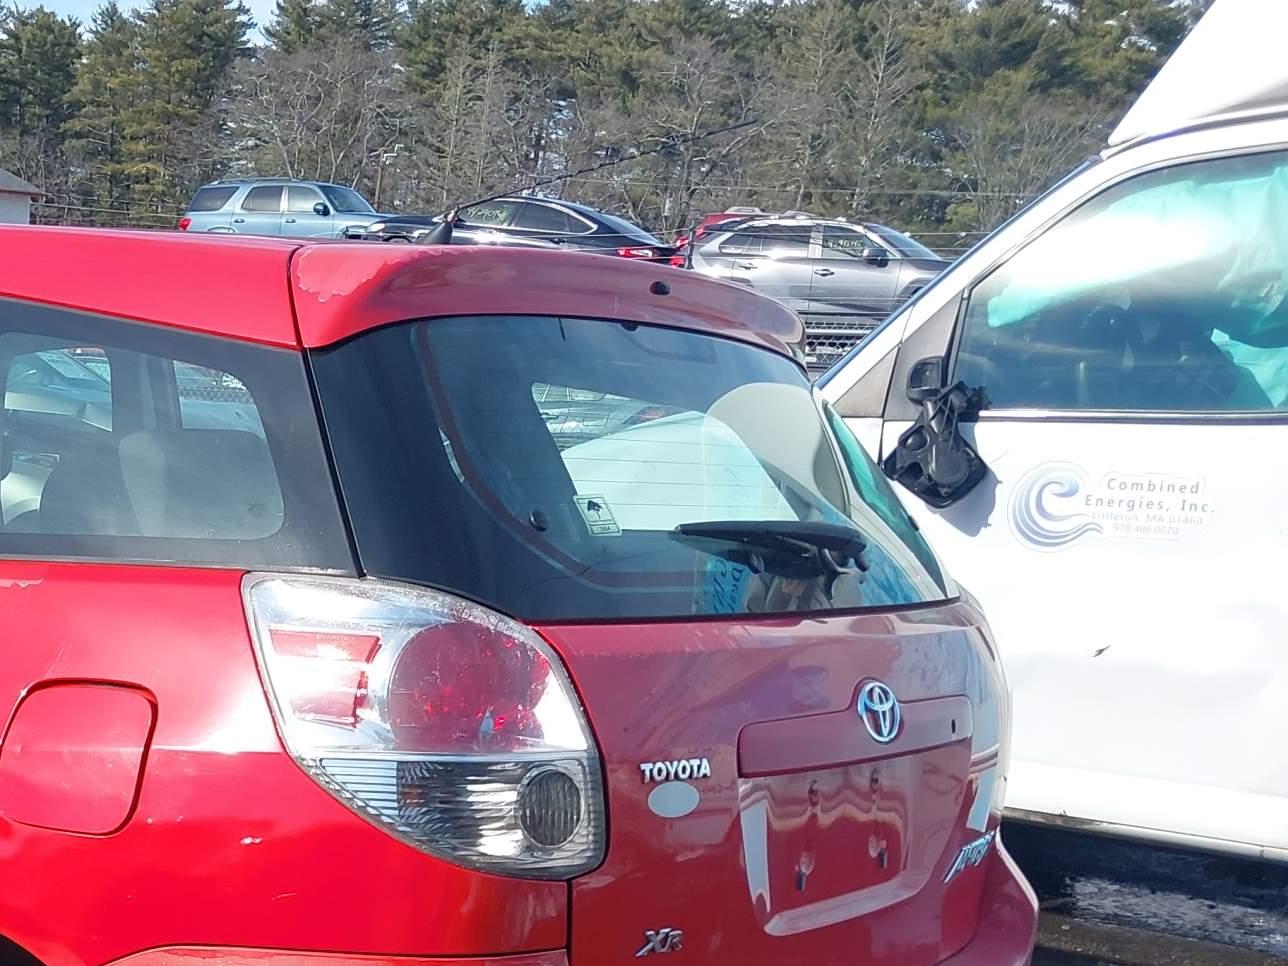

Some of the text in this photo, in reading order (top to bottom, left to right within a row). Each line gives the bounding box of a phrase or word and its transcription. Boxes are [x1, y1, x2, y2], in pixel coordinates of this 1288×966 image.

[1106, 477, 1200, 495] Combined
[1084, 494, 1216, 513] Energies, Inc.
[1145, 514, 1164, 523] MA
[639, 757, 711, 784] TOYOTA
[634, 927, 684, 958] XR
